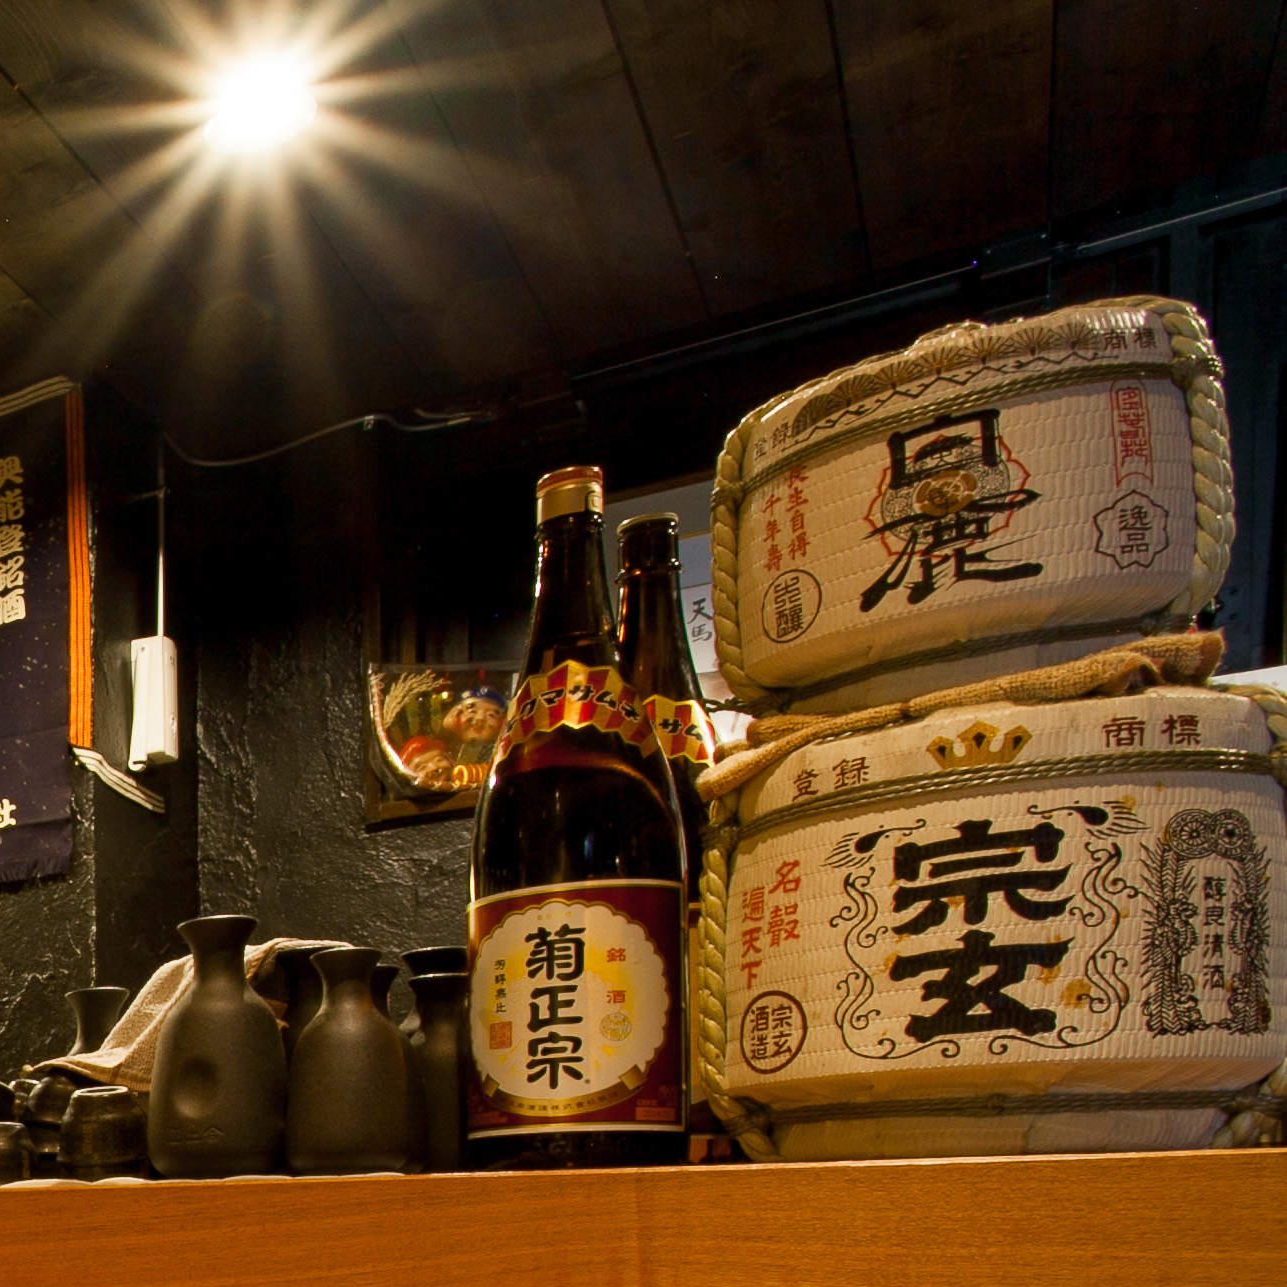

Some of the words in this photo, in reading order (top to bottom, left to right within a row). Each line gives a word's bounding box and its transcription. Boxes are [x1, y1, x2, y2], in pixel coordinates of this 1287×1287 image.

[1103, 326, 1157, 351] 商標
[1117, 504, 1153, 555] 逸品
[792, 756, 870, 802] 登録
[1102, 715, 1202, 749] 商標
[889, 819, 1076, 1045] 宗玄
[1202, 875, 1227, 991] 醇良清酒
[525, 923, 587, 1090] 菊正宗
[606, 947, 627, 1005] 銘酒
